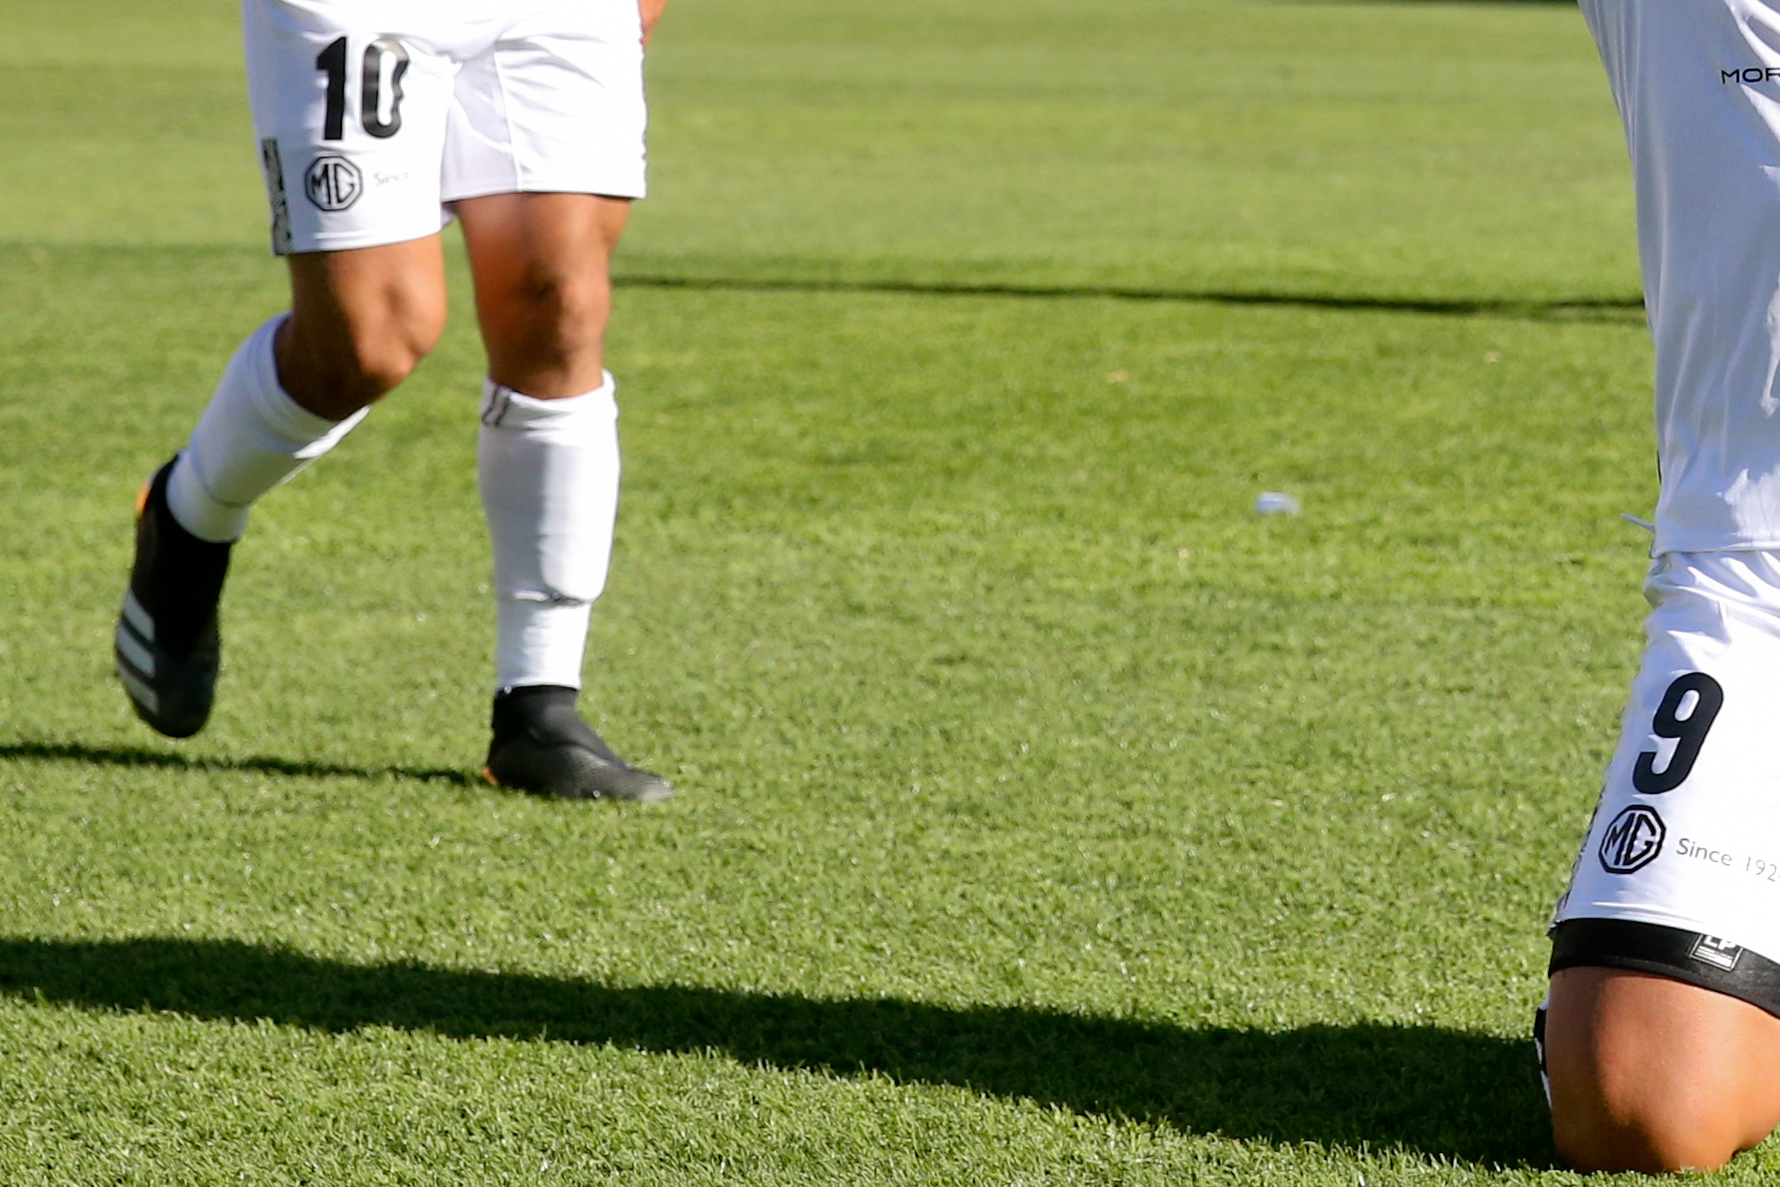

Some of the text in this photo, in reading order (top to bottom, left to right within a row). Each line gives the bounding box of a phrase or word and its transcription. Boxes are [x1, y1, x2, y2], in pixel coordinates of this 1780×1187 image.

[315, 35, 411, 140] 10
[311, 162, 355, 205] MG
[1632, 671, 1725, 796] 9
[1604, 812, 1657, 868] MG
[1675, 837, 1733, 867] Since
